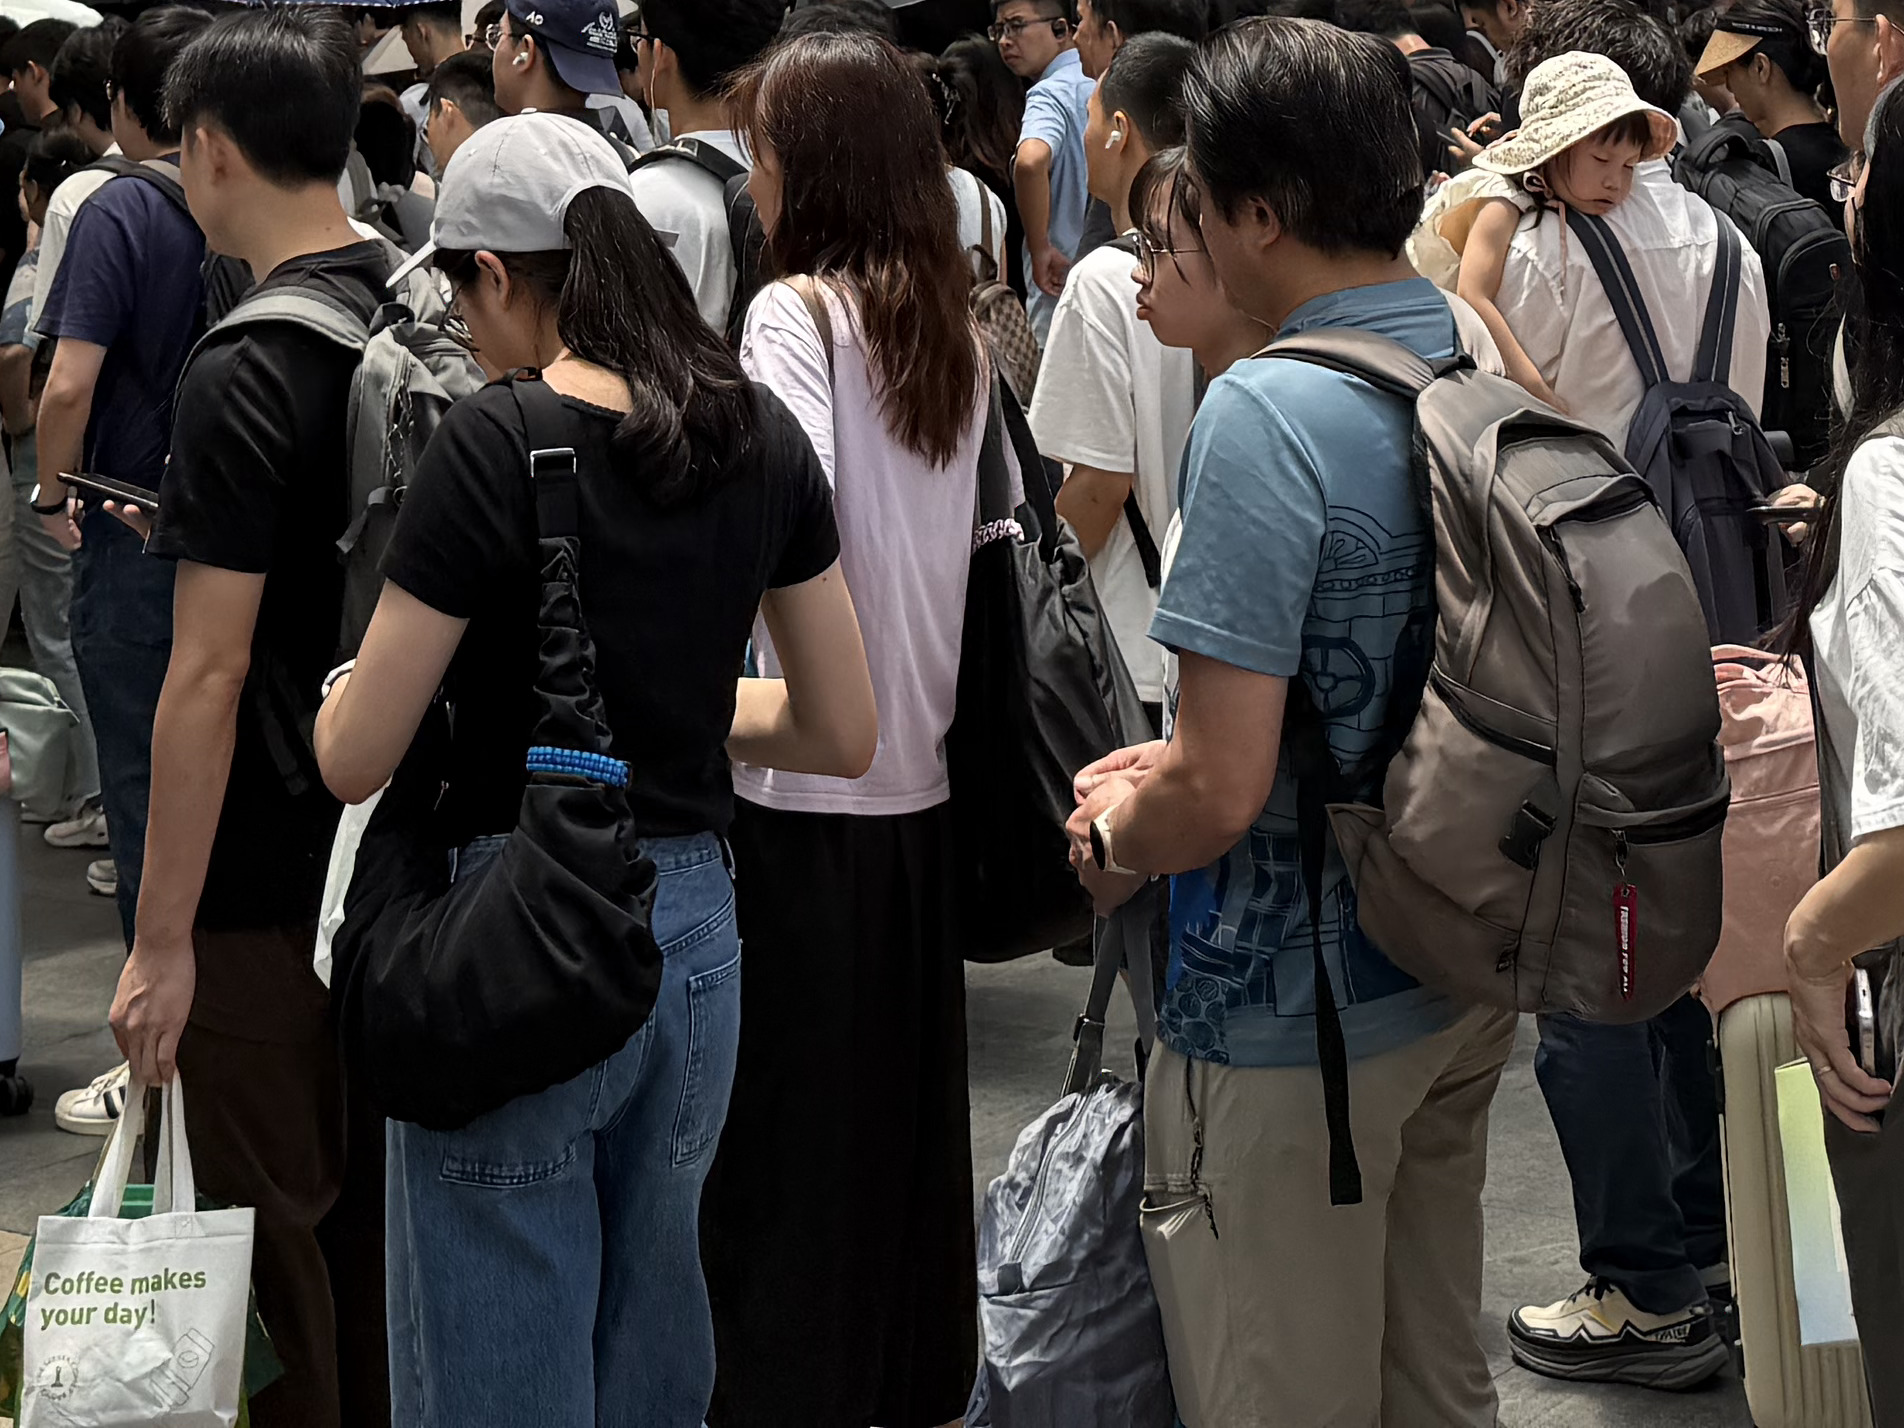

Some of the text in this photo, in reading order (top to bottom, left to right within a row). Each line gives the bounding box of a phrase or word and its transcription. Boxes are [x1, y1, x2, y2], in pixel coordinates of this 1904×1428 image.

[44, 1267, 206, 1295] Coffee makes
[41, 1299, 155, 1331] your day!
